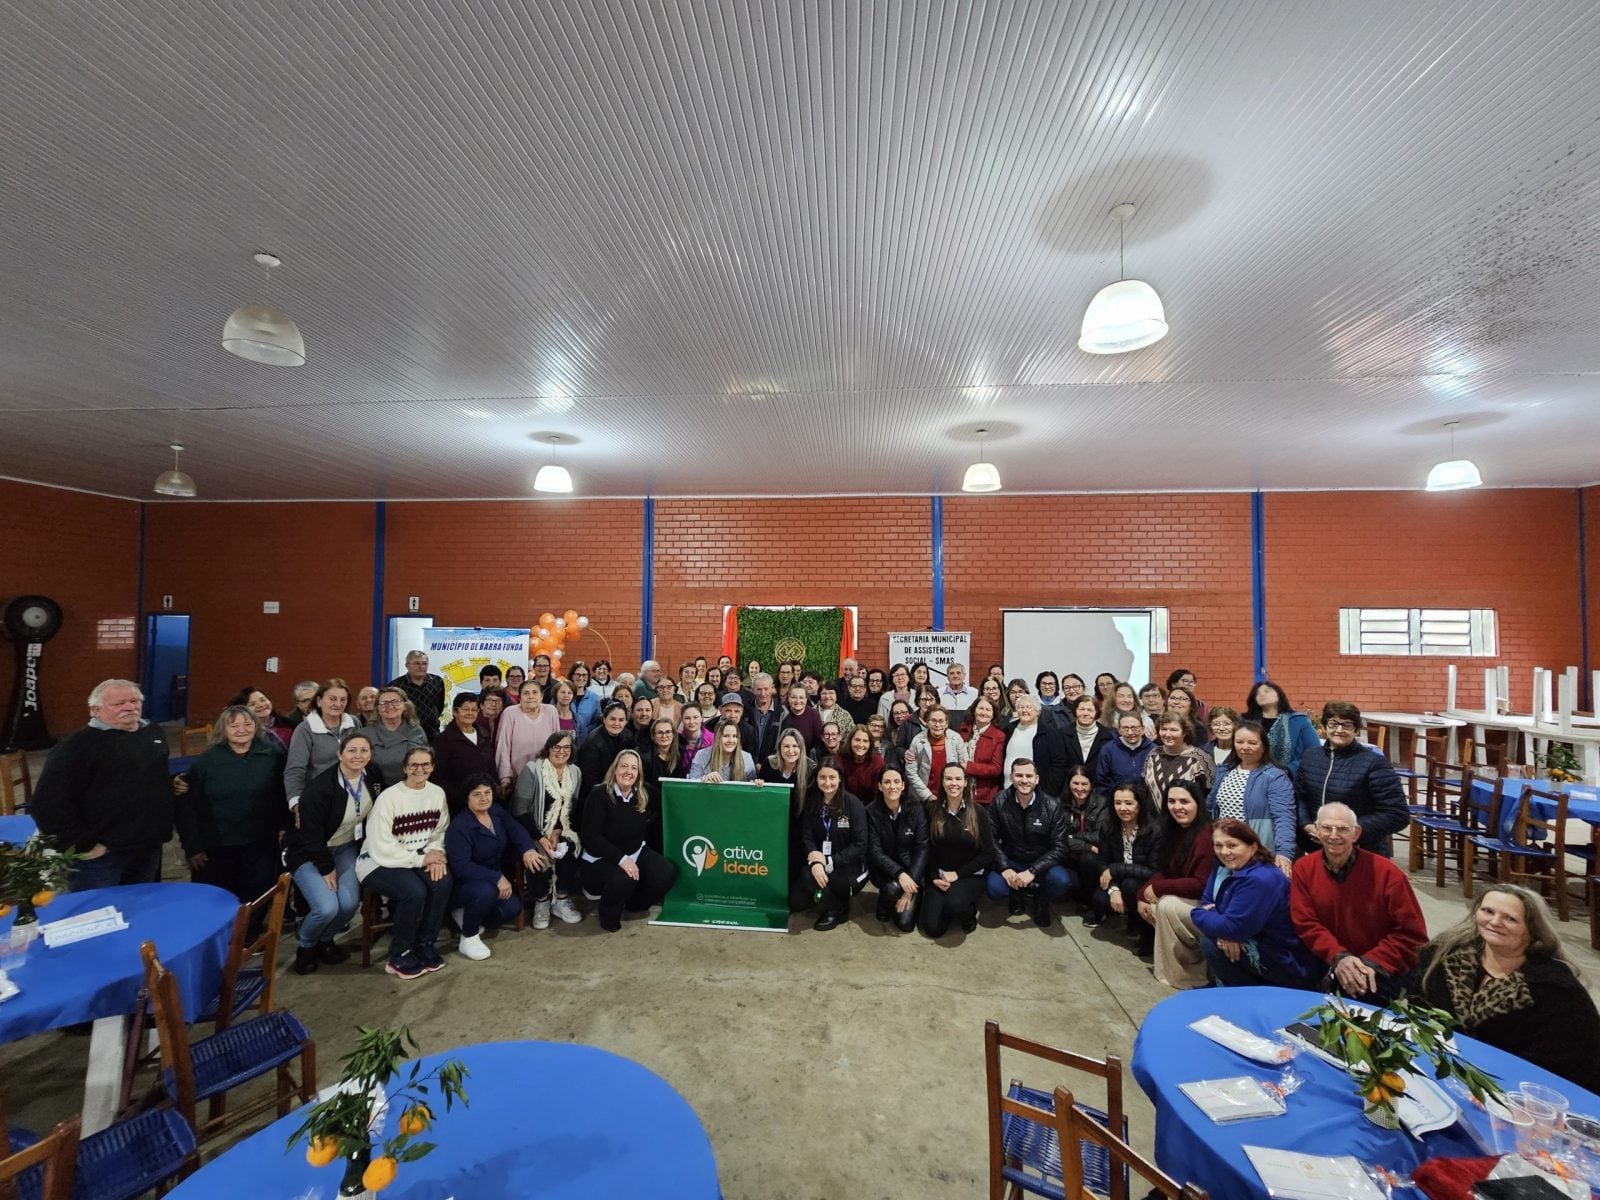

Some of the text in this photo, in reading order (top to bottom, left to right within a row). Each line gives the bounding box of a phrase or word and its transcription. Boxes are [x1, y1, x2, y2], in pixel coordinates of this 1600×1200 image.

[893, 635, 968, 644] SECRETARIA MUNICIPAL
[430, 642, 523, 651] MUNICÍPIO DE BARRA FUNDA
[935, 657, 955, 665] SMAS
[723, 846, 763, 861] ativa
[723, 860, 769, 876] idade
